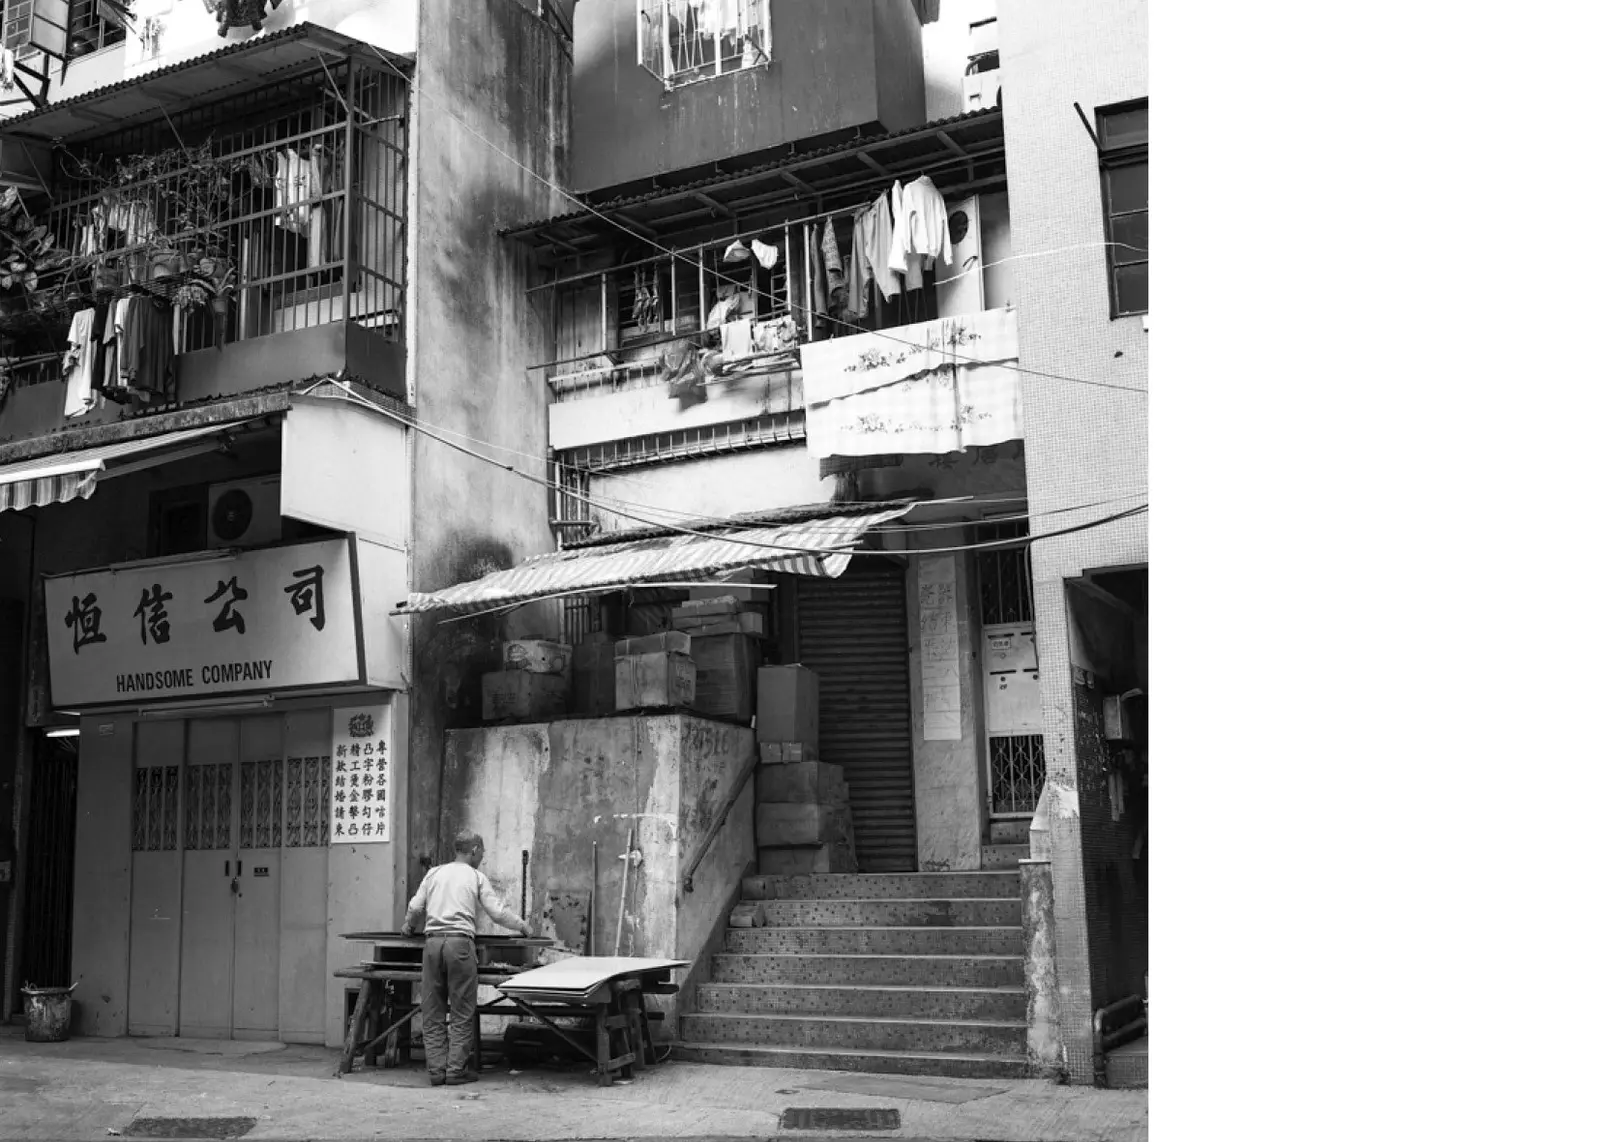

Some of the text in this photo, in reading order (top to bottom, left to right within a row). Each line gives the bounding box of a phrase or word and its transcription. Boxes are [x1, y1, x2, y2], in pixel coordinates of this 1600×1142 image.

[65, 565, 325, 655] 恒信公司
[116, 660, 273, 693] HANDSOME COMPANY
